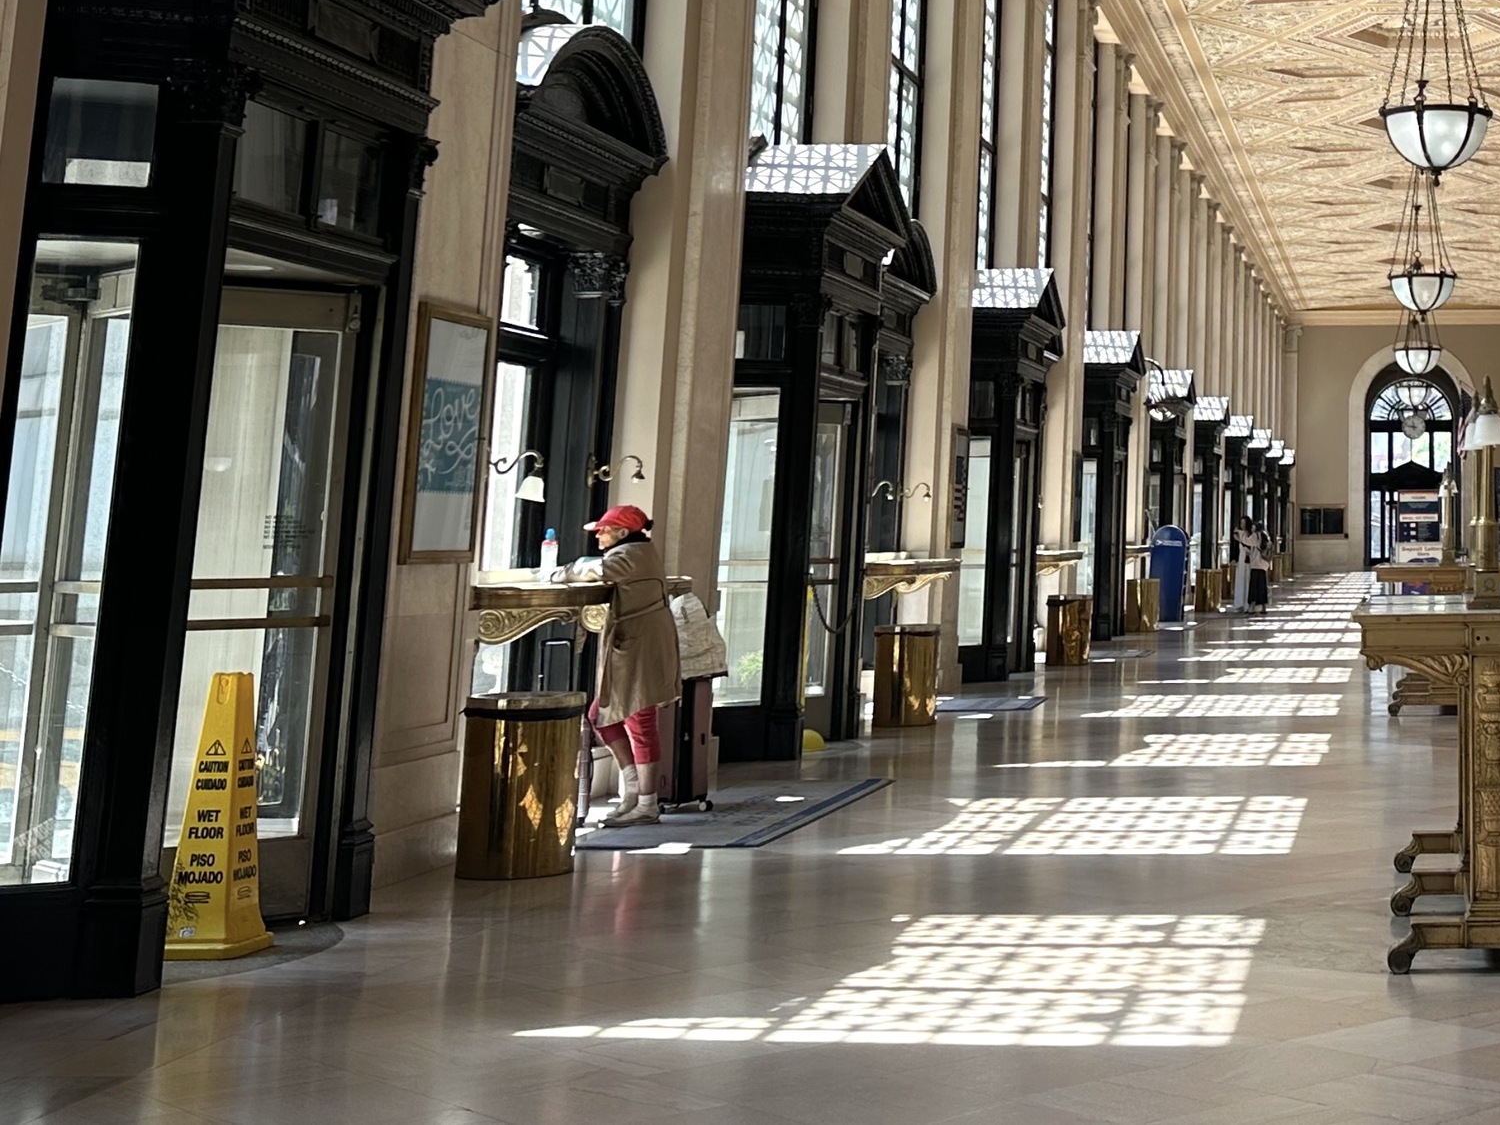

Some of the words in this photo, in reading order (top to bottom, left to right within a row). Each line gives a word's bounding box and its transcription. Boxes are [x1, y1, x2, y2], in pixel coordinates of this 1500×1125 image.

[198, 760, 229, 773] CAUTION
[195, 778, 227, 791] CUIDADO
[197, 809, 221, 823] WET
[240, 806, 252, 819] WET
[188, 826, 224, 840] FLOOR
[236, 822, 255, 837] FLOOR
[190, 854, 215, 867] PISO
[238, 849, 252, 863] PISO
[178, 871, 223, 885] MOJADO
